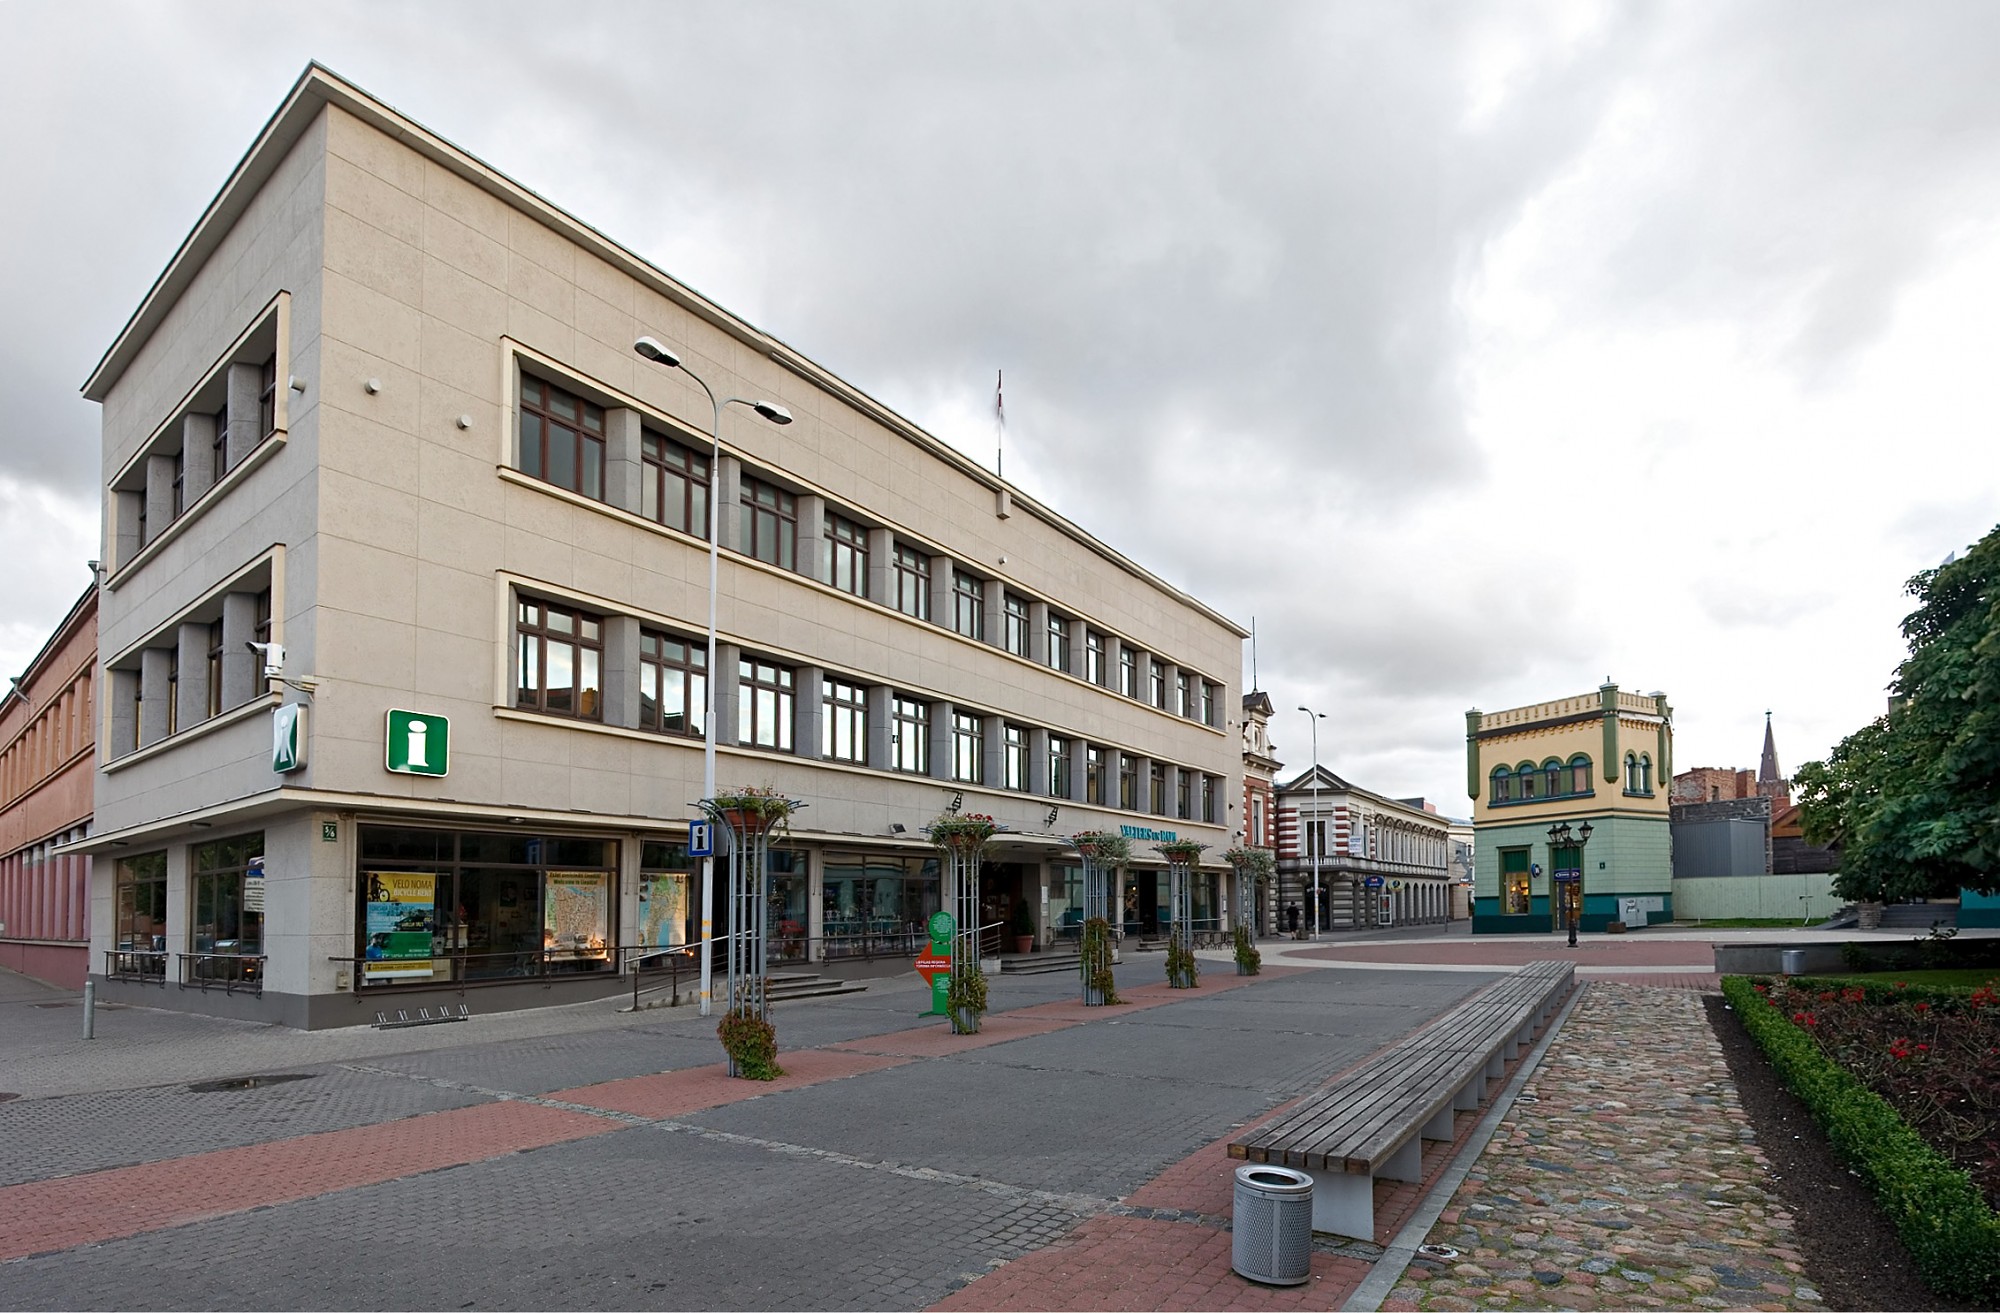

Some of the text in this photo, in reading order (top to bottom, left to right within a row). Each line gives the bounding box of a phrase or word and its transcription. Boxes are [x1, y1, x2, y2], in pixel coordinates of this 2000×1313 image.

[407, 720, 429, 767] i
[696, 826, 704, 850] i
[392, 879, 433, 889] VELO NOMA
